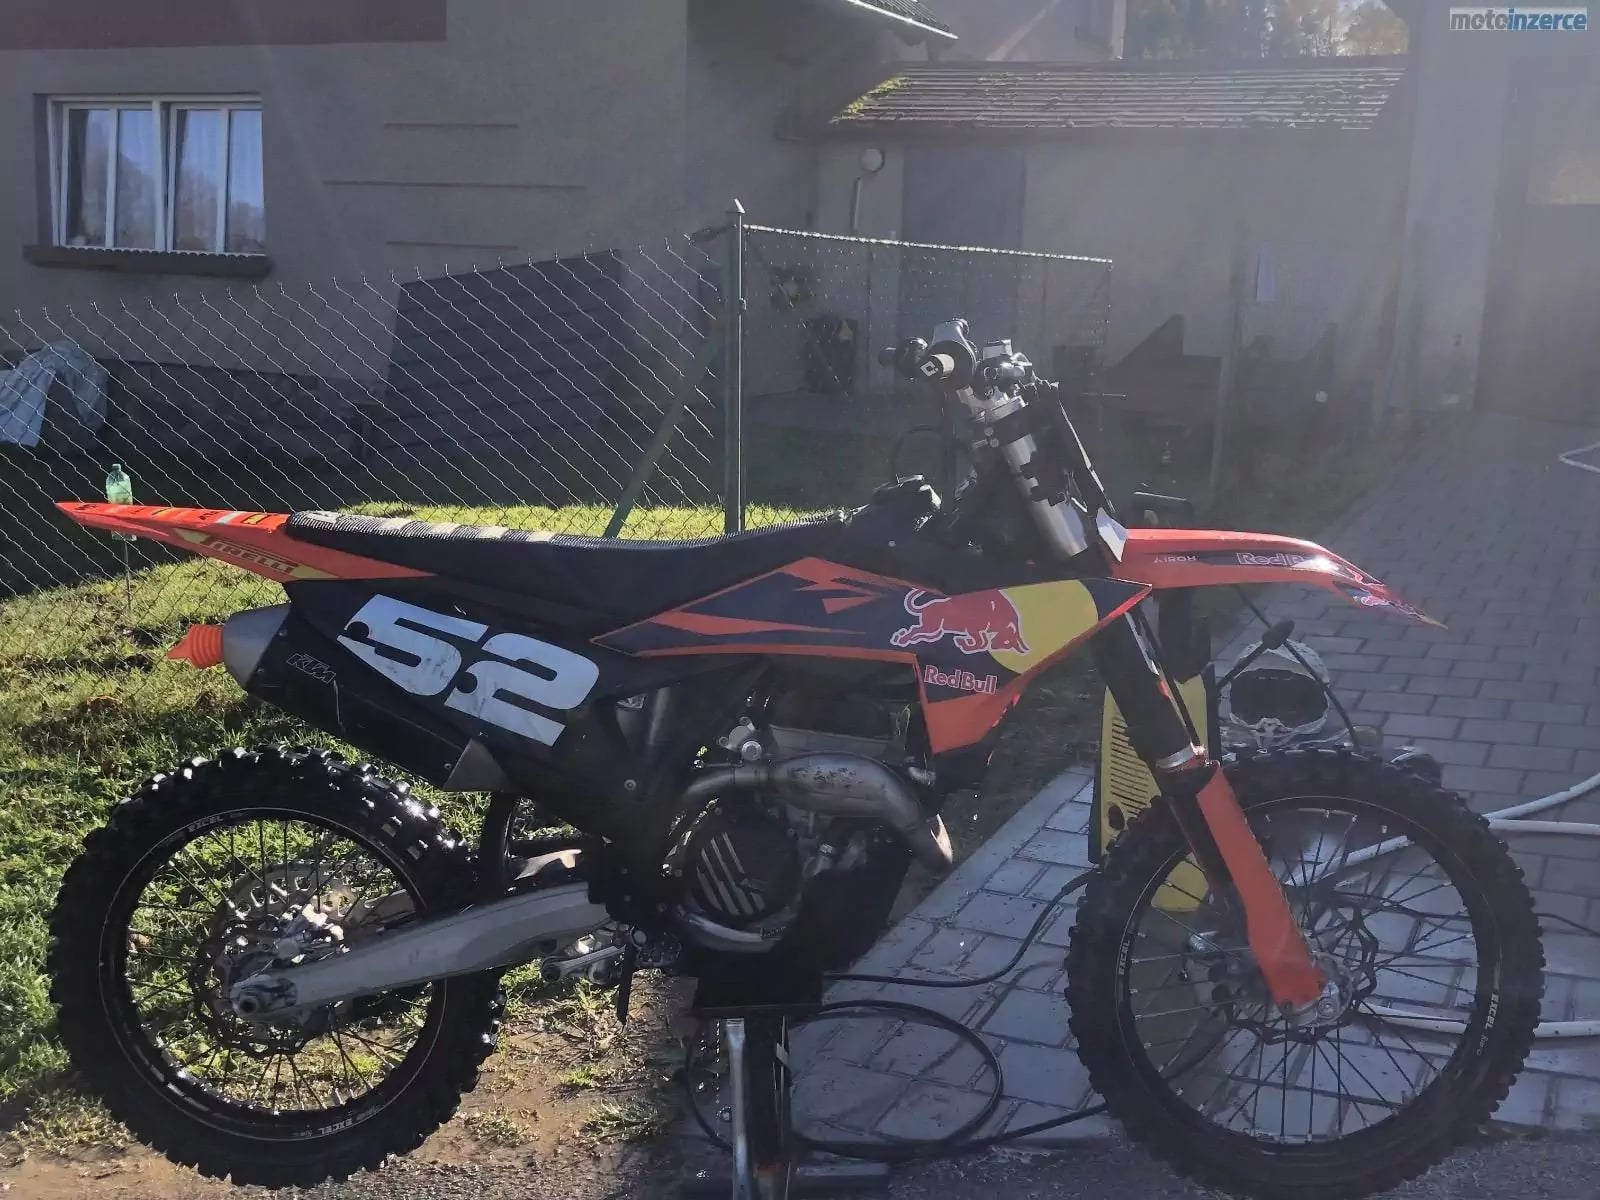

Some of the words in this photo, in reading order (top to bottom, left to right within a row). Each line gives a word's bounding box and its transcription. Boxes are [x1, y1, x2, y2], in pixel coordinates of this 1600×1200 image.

[285, 653, 336, 684] KTM
[336, 593, 600, 747] 52
[924, 665, 961, 689] Red
[960, 671, 998, 695] Bull
